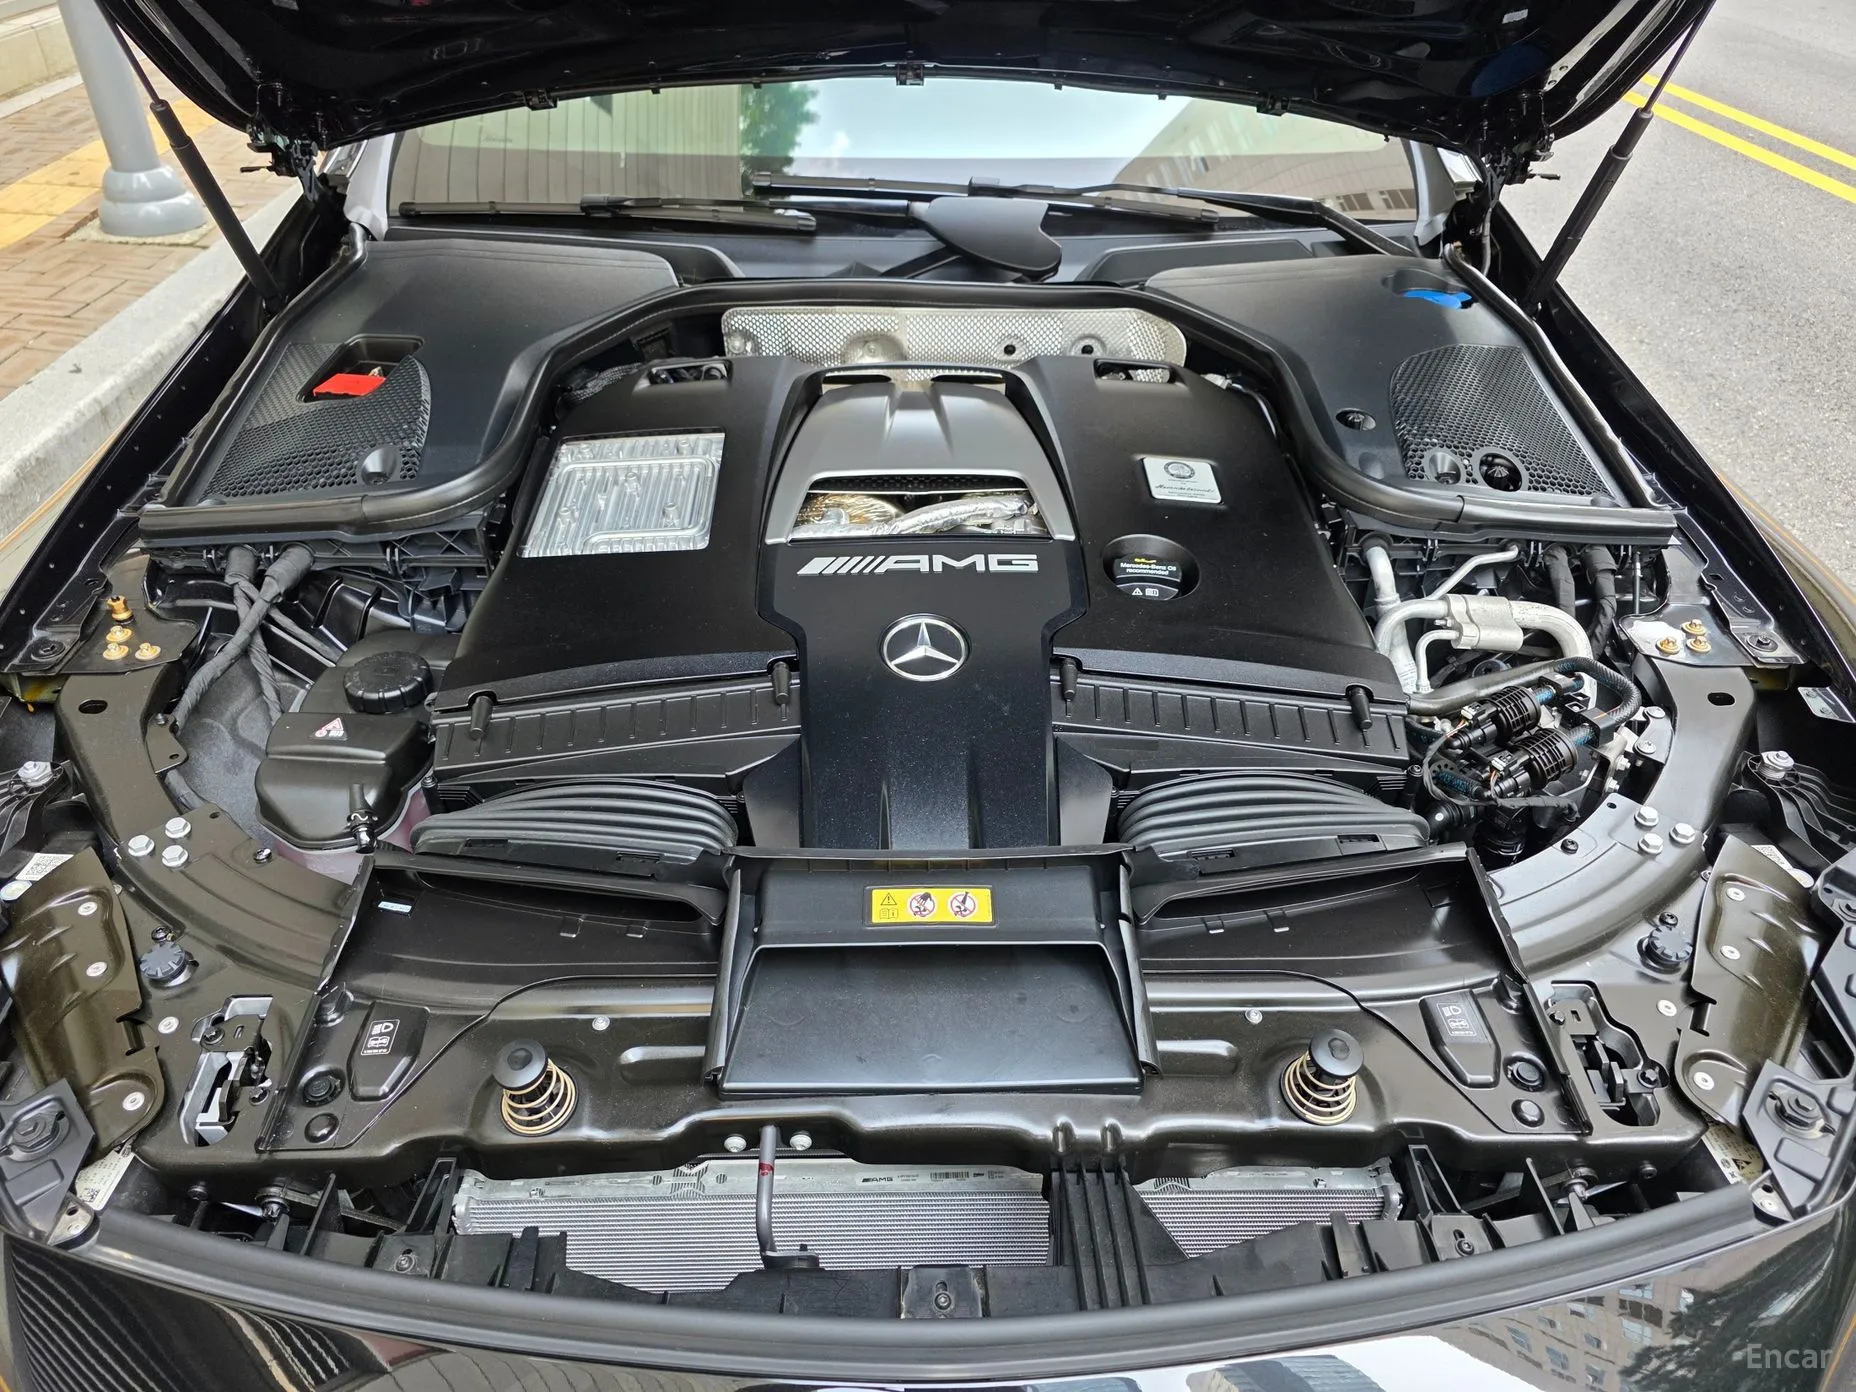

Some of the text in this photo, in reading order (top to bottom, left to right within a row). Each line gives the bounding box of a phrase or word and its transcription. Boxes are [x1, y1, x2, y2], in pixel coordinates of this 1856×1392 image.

[873, 554, 1039, 574] AMG
[1120, 562, 1167, 571] Mercedes-Benz
[1126, 568, 1169, 576] recommended
